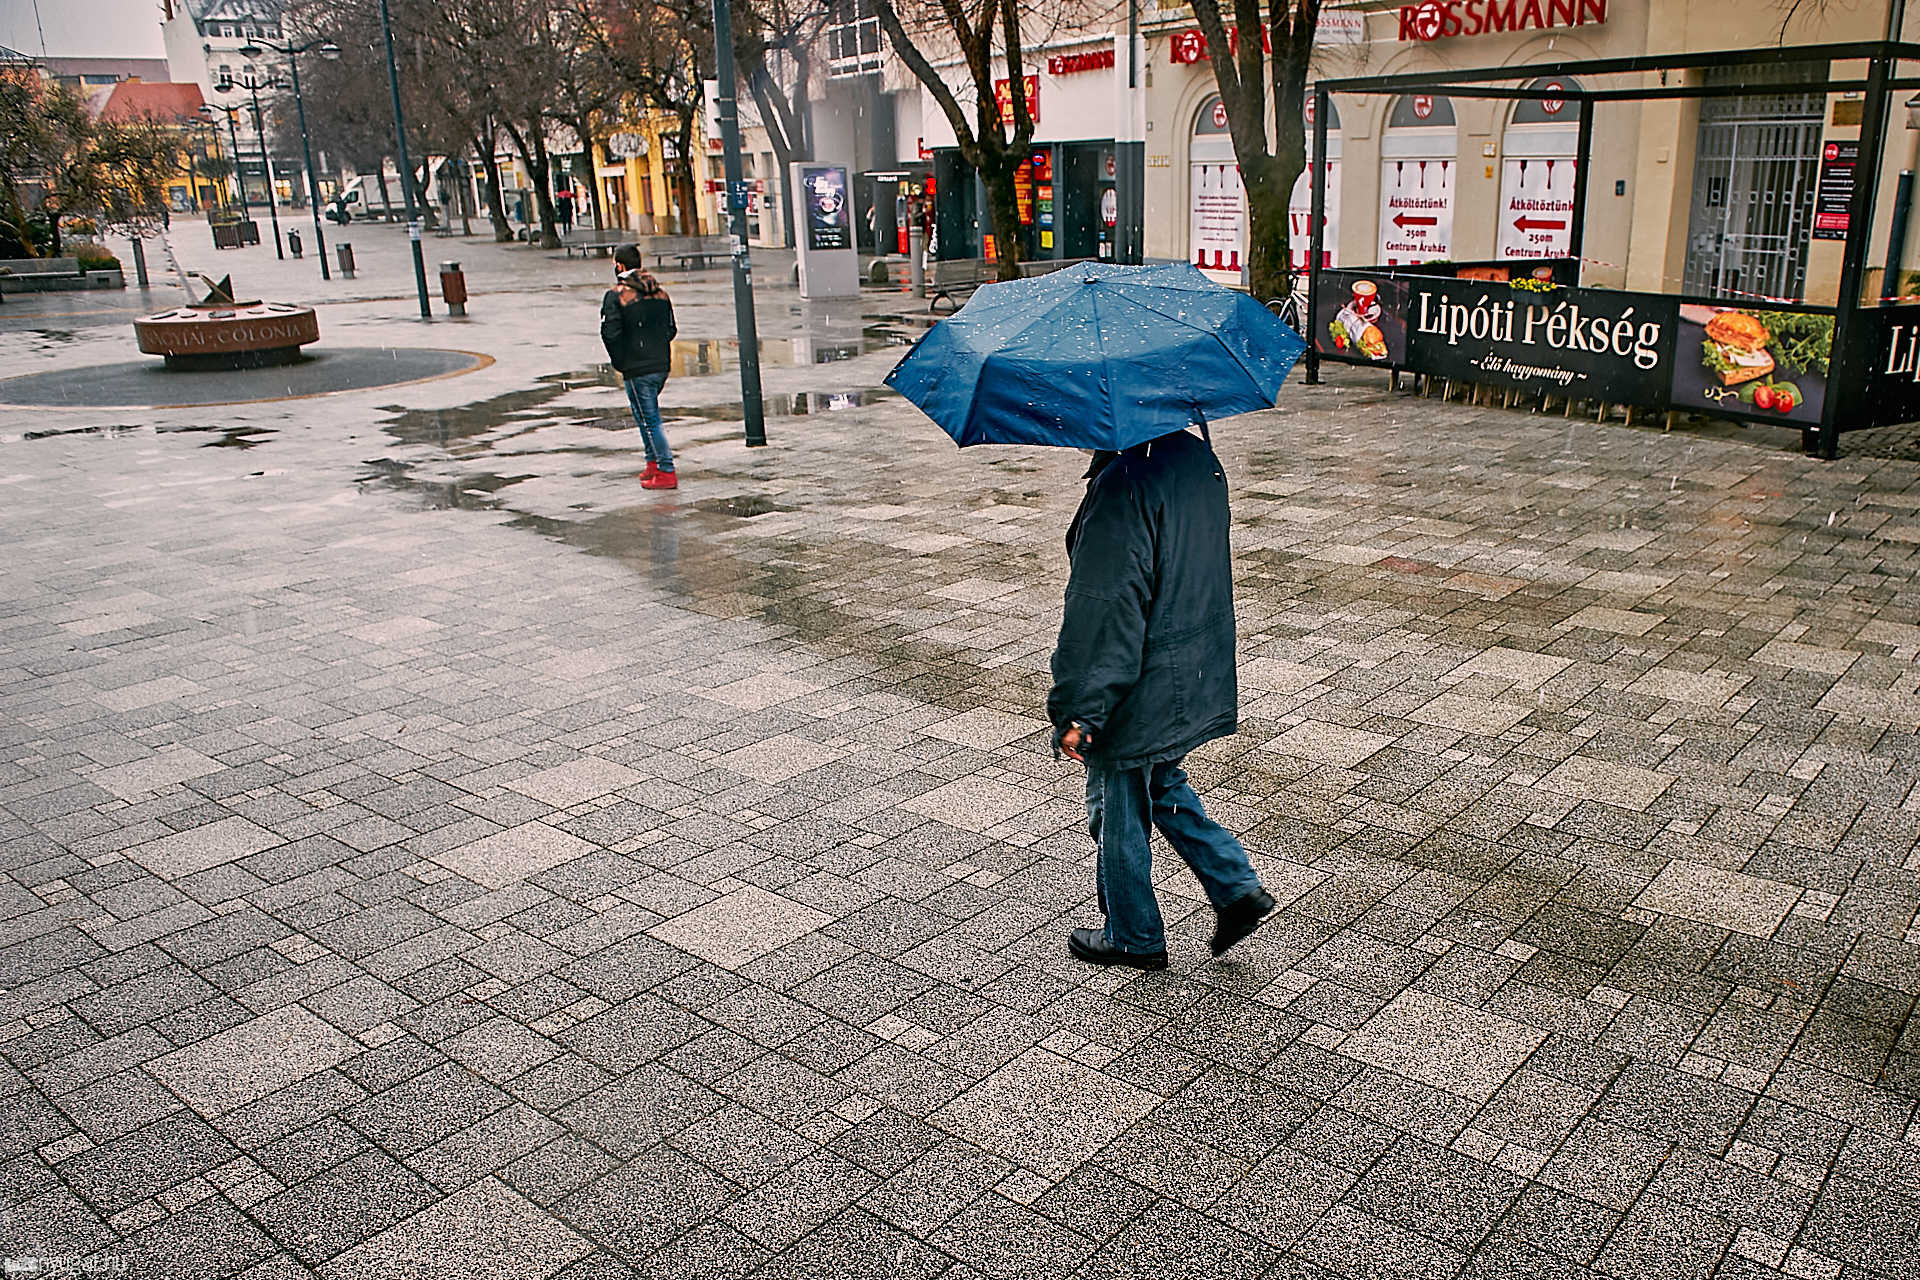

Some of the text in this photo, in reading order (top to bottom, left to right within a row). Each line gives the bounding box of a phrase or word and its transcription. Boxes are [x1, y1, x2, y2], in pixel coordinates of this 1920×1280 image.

[1399, 0, 1607, 41] ROSSMANN
[1389, 195, 1447, 209] Átköltöztünk!
[1405, 229, 1427, 238] 250m
[1528, 234, 1553, 243] 250m
[1386, 241, 1446, 253] Centrum Áruház
[1504, 246, 1542, 258] Centrum
[1417, 292, 1661, 370] Lipóti Pékség
[1502, 357, 1575, 386] hagyomány
